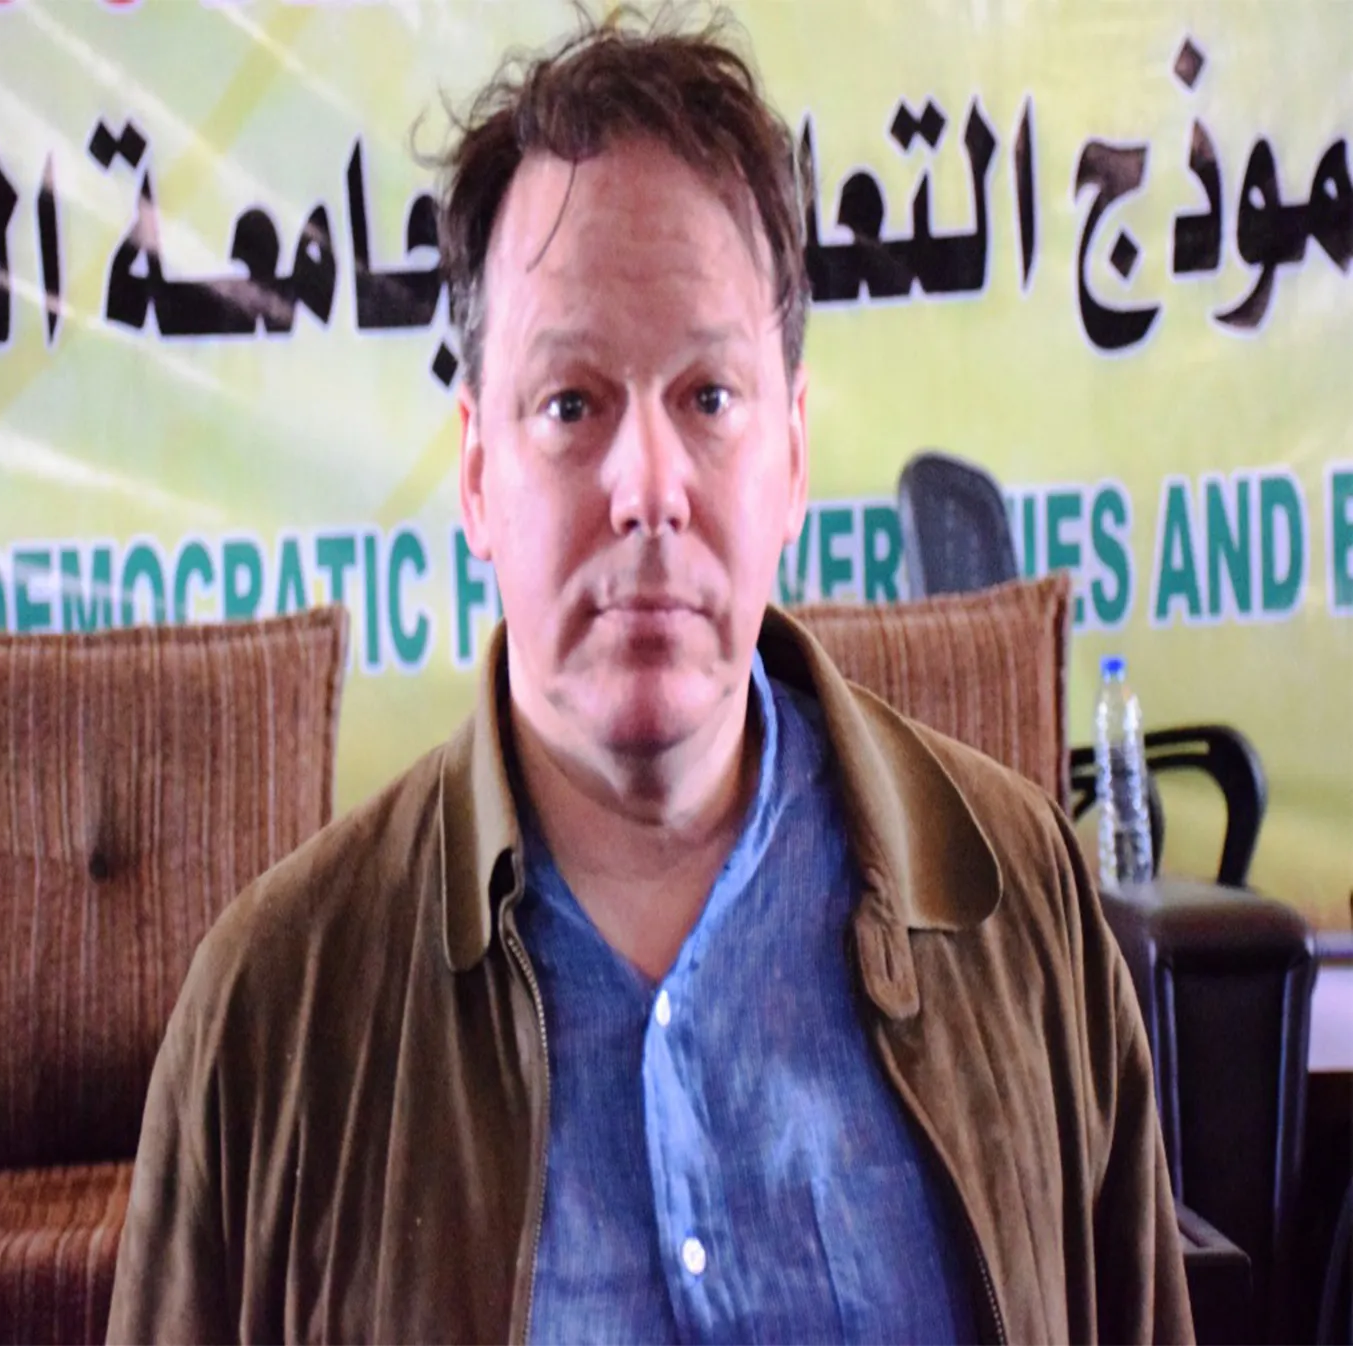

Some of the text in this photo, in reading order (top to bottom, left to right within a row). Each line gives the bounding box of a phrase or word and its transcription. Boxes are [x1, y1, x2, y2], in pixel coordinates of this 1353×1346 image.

[89, 120, 459, 387] جامعة
[800, 97, 1035, 302] التعل
[1073, 37, 1353, 350] موذج
[1155, 475, 1304, 619] AND
